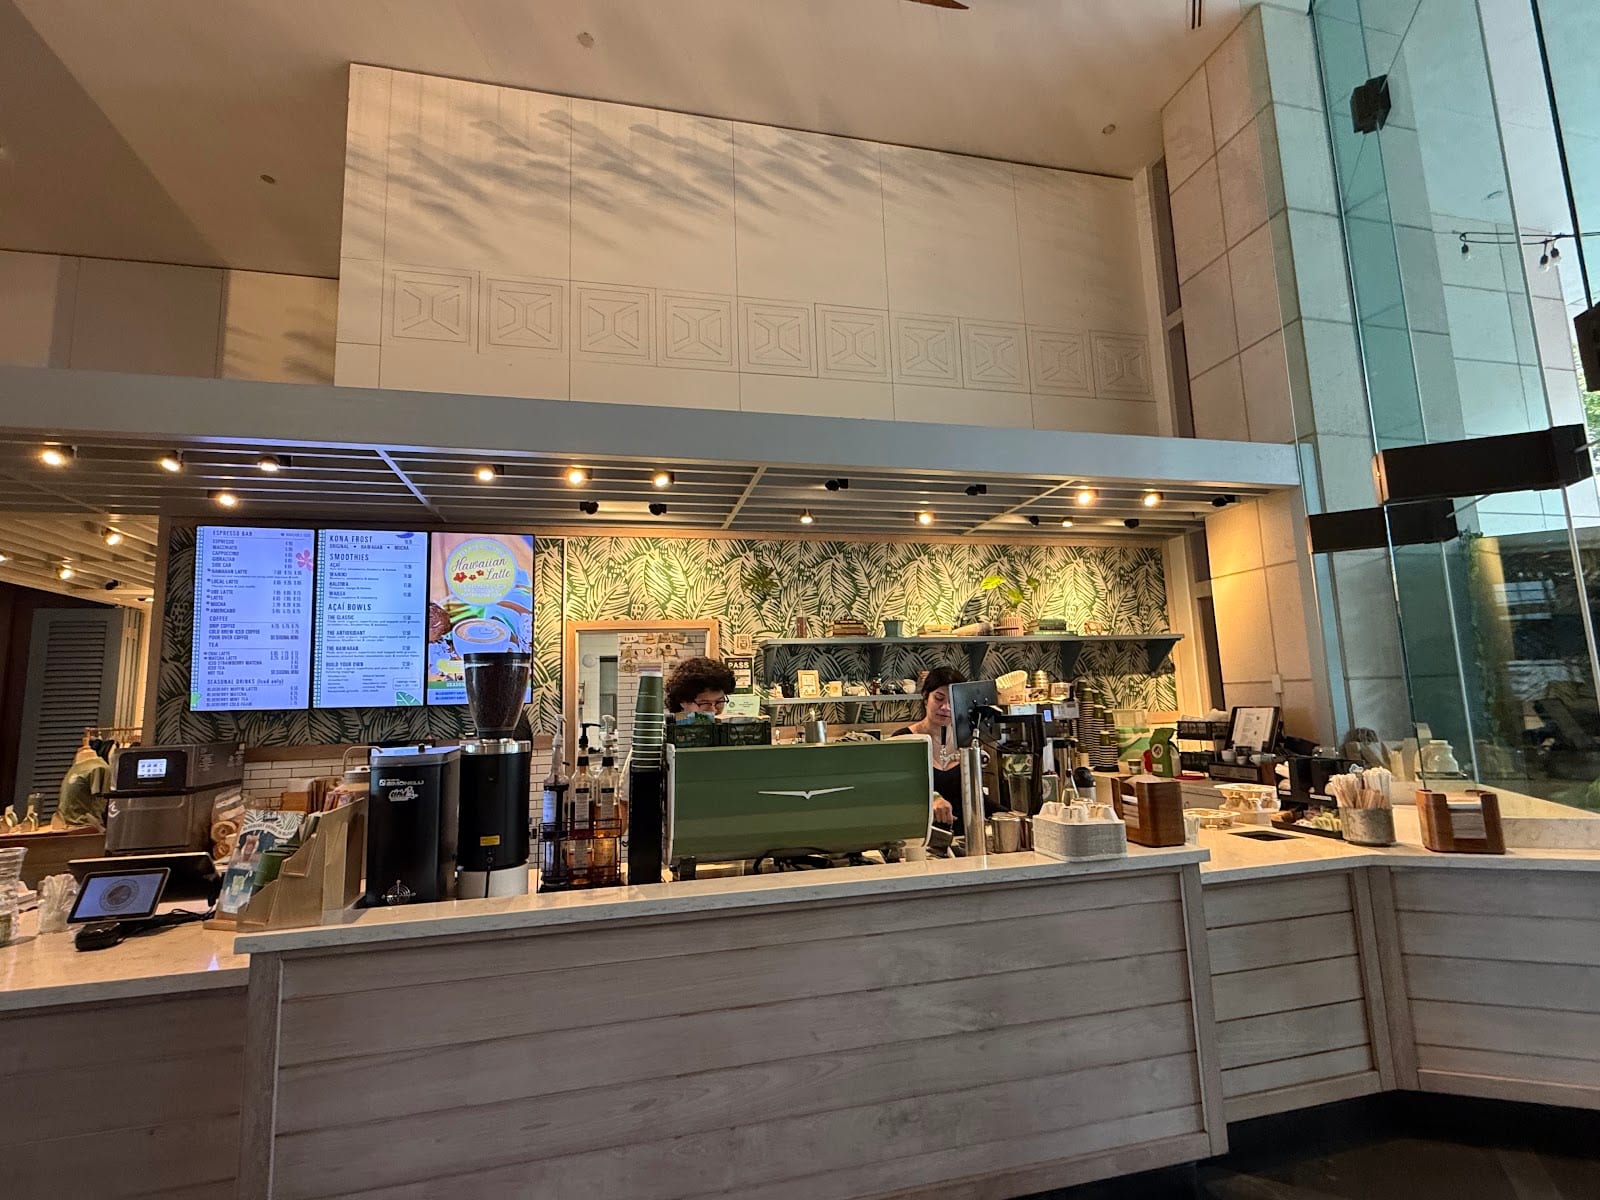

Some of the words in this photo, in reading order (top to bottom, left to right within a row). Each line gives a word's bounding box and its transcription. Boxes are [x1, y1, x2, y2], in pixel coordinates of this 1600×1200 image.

[452, 556, 506, 572] Hawaiian
[486, 568, 510, 580] Latte
[328, 603, 345, 611] AÇAÍ
